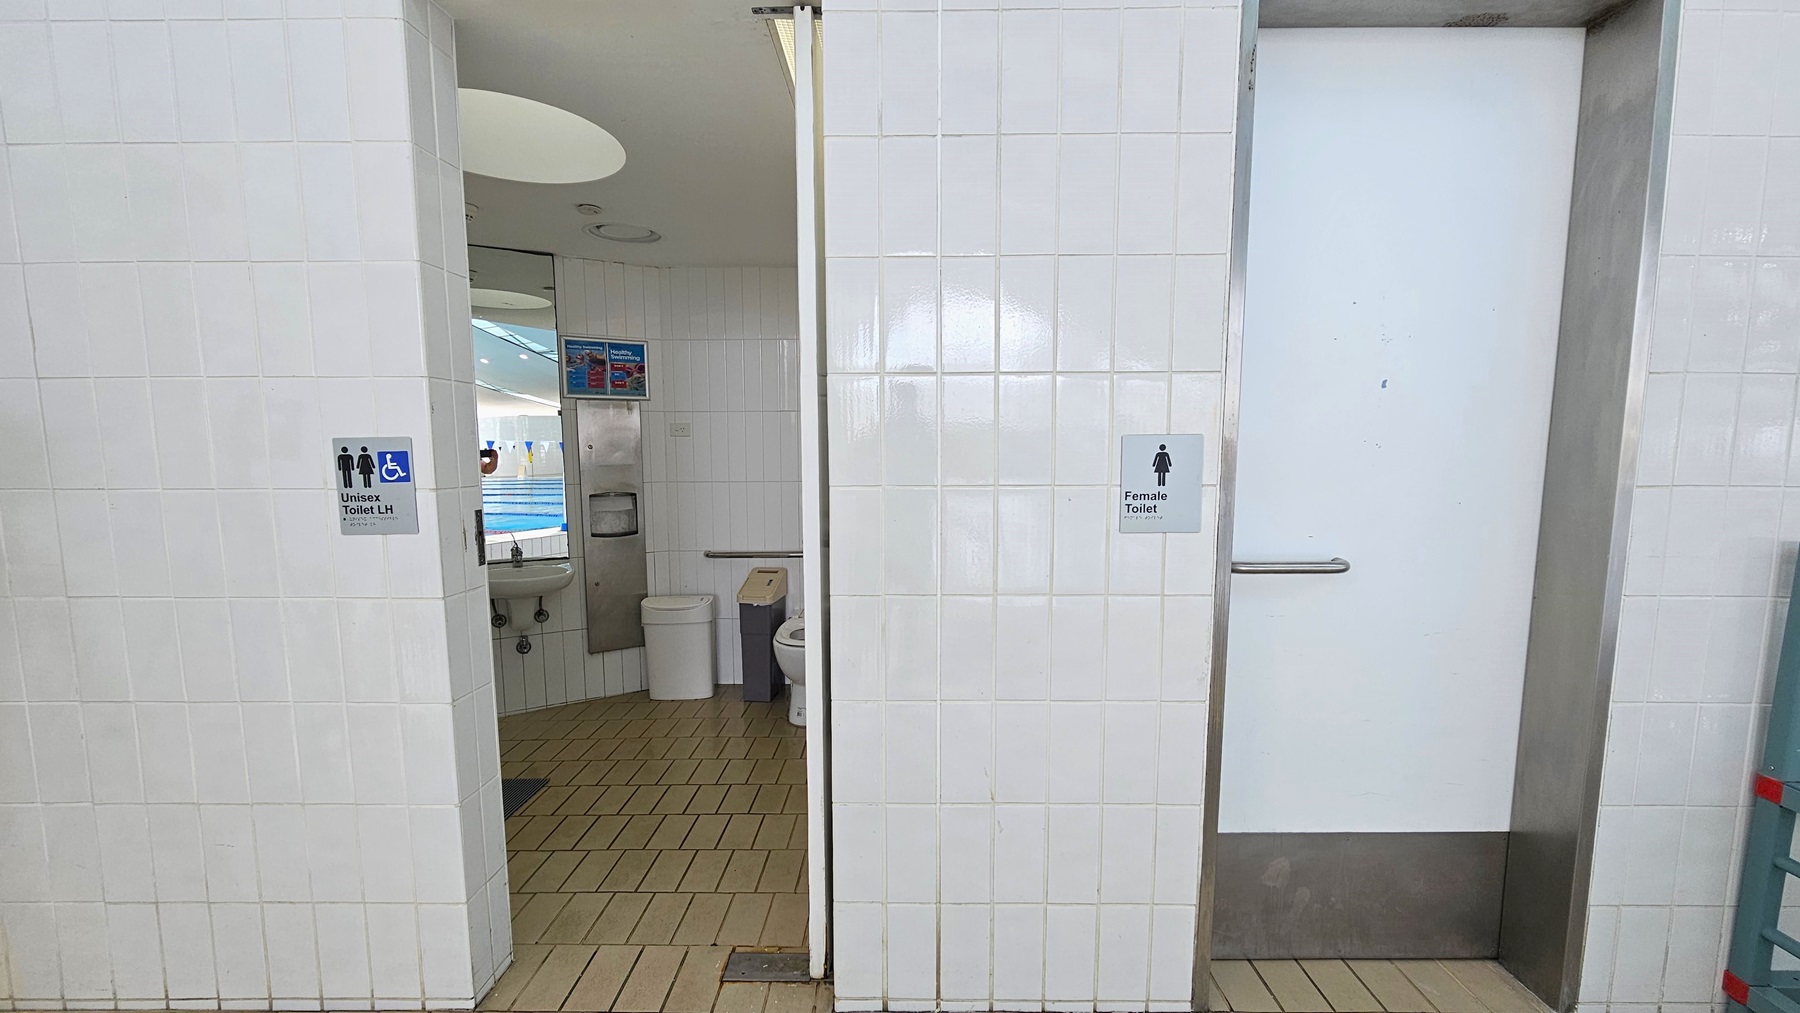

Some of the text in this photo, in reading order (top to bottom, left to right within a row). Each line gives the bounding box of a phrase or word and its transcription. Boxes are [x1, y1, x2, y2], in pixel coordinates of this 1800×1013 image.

[610, 354, 641, 362] Swimming
[341, 492, 381, 503] Unisex
[1124, 491, 1168, 501] Female
[342, 504, 394, 515] Toilet LH
[1125, 503, 1157, 514] Toilet
